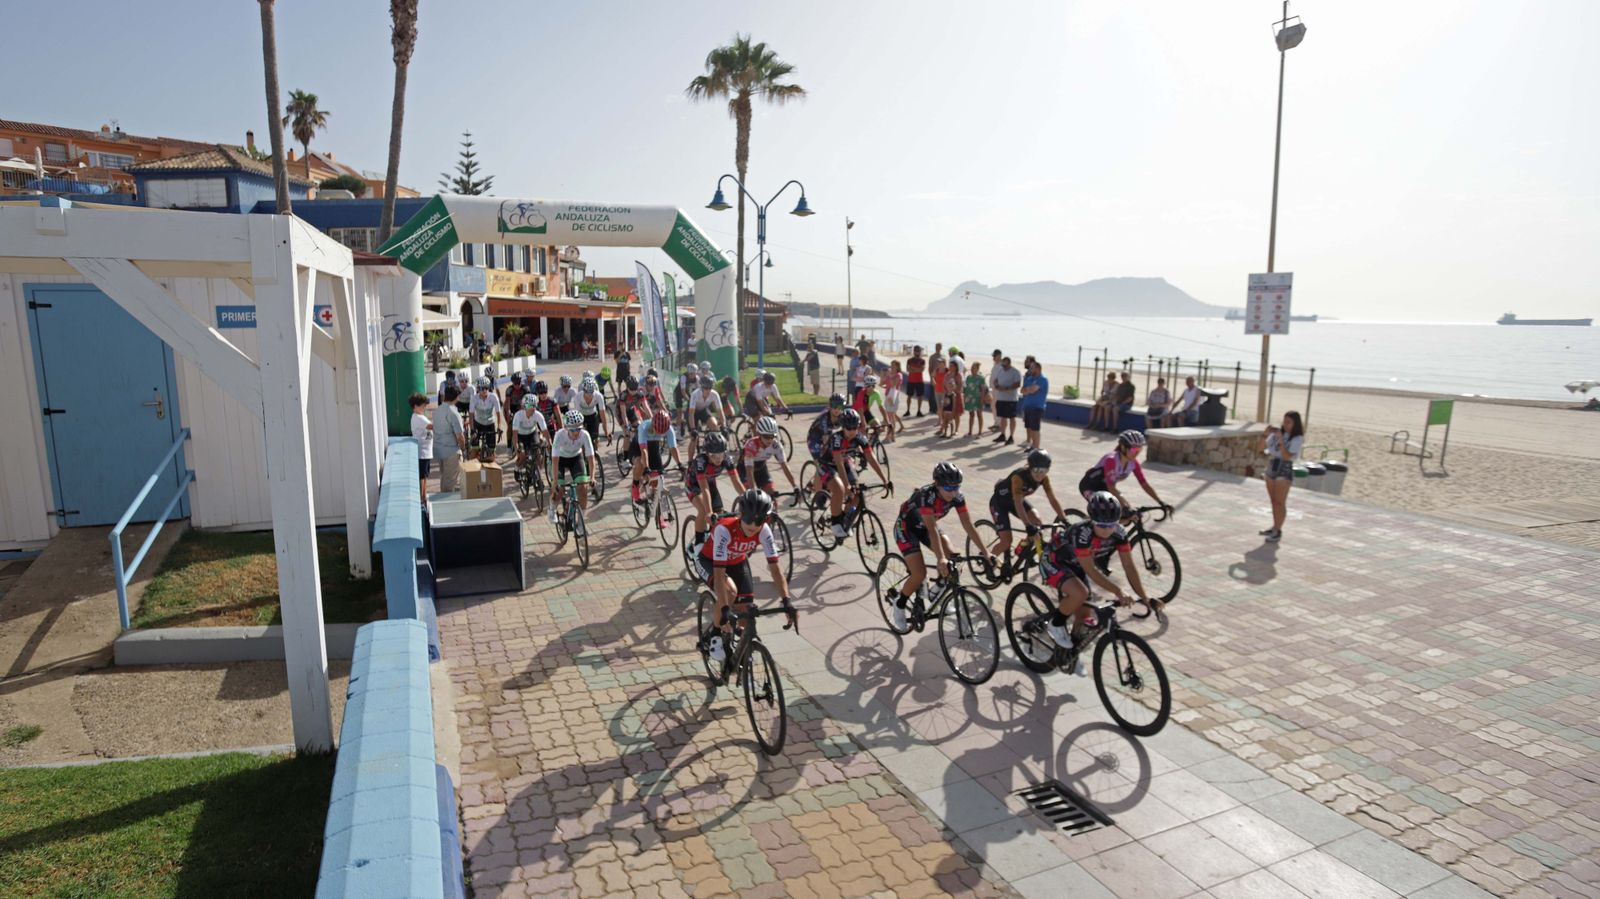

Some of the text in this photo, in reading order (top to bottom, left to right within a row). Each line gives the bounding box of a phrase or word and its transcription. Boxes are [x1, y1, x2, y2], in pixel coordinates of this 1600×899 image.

[555, 213, 610, 222] ANDALUZA
[571, 222, 634, 233] DE CICLISMO
[399, 230, 434, 262] ANDALUZA
[414, 222, 453, 259] DE CICLISMO
[677, 226, 707, 256] ANDALUZA
[680, 239, 715, 272] DE CICLISMO
